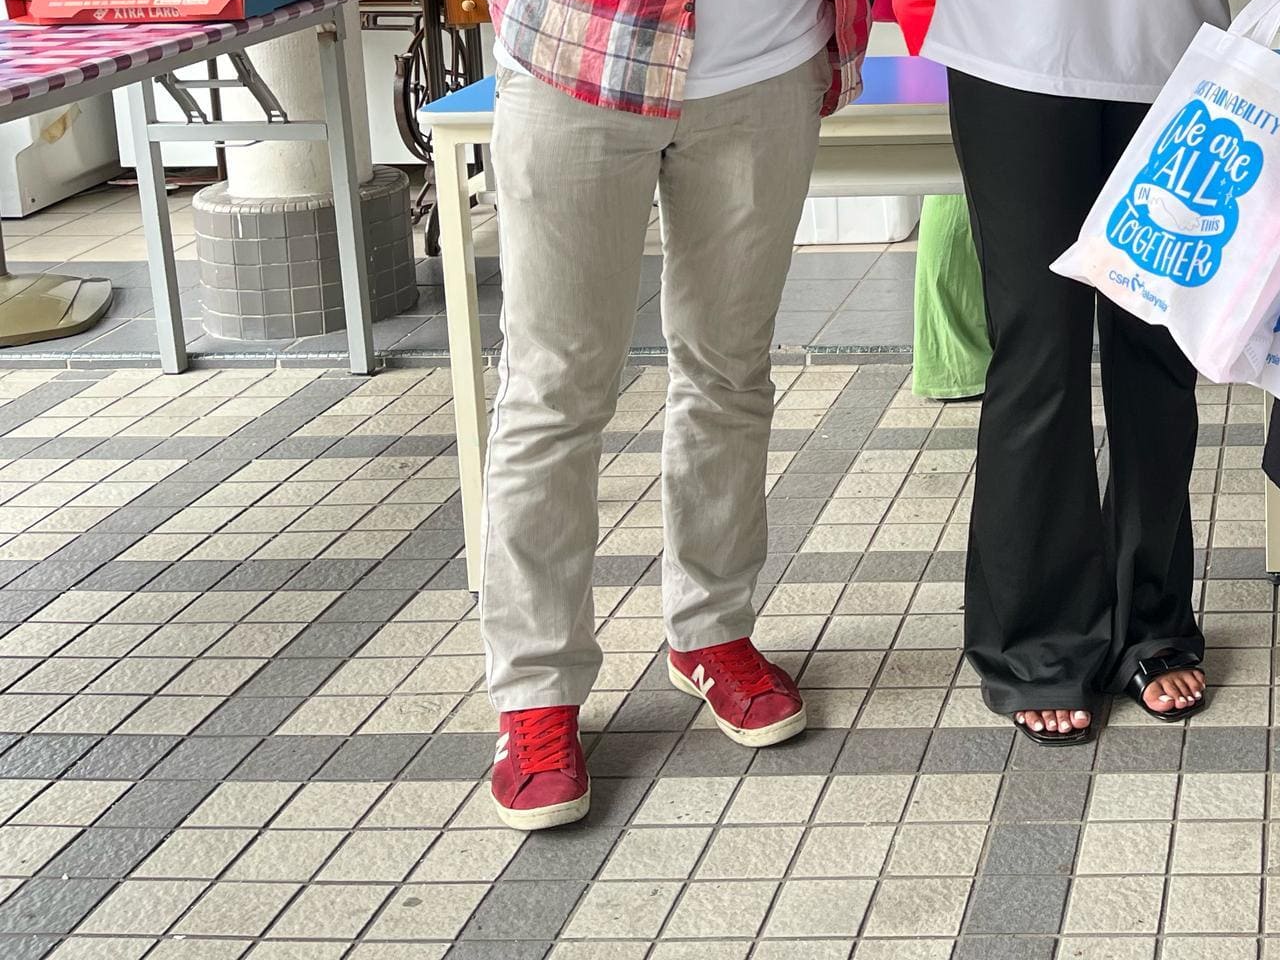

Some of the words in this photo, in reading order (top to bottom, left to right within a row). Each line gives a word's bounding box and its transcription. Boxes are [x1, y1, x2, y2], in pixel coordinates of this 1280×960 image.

[1157, 108, 1206, 155] We
[1209, 134, 1251, 182] are
[1138, 186, 1151, 200] IN
[1153, 147, 1222, 208] ALL
[1110, 199, 1212, 282] TOGETHER
[1109, 270, 1130, 288] CSR
